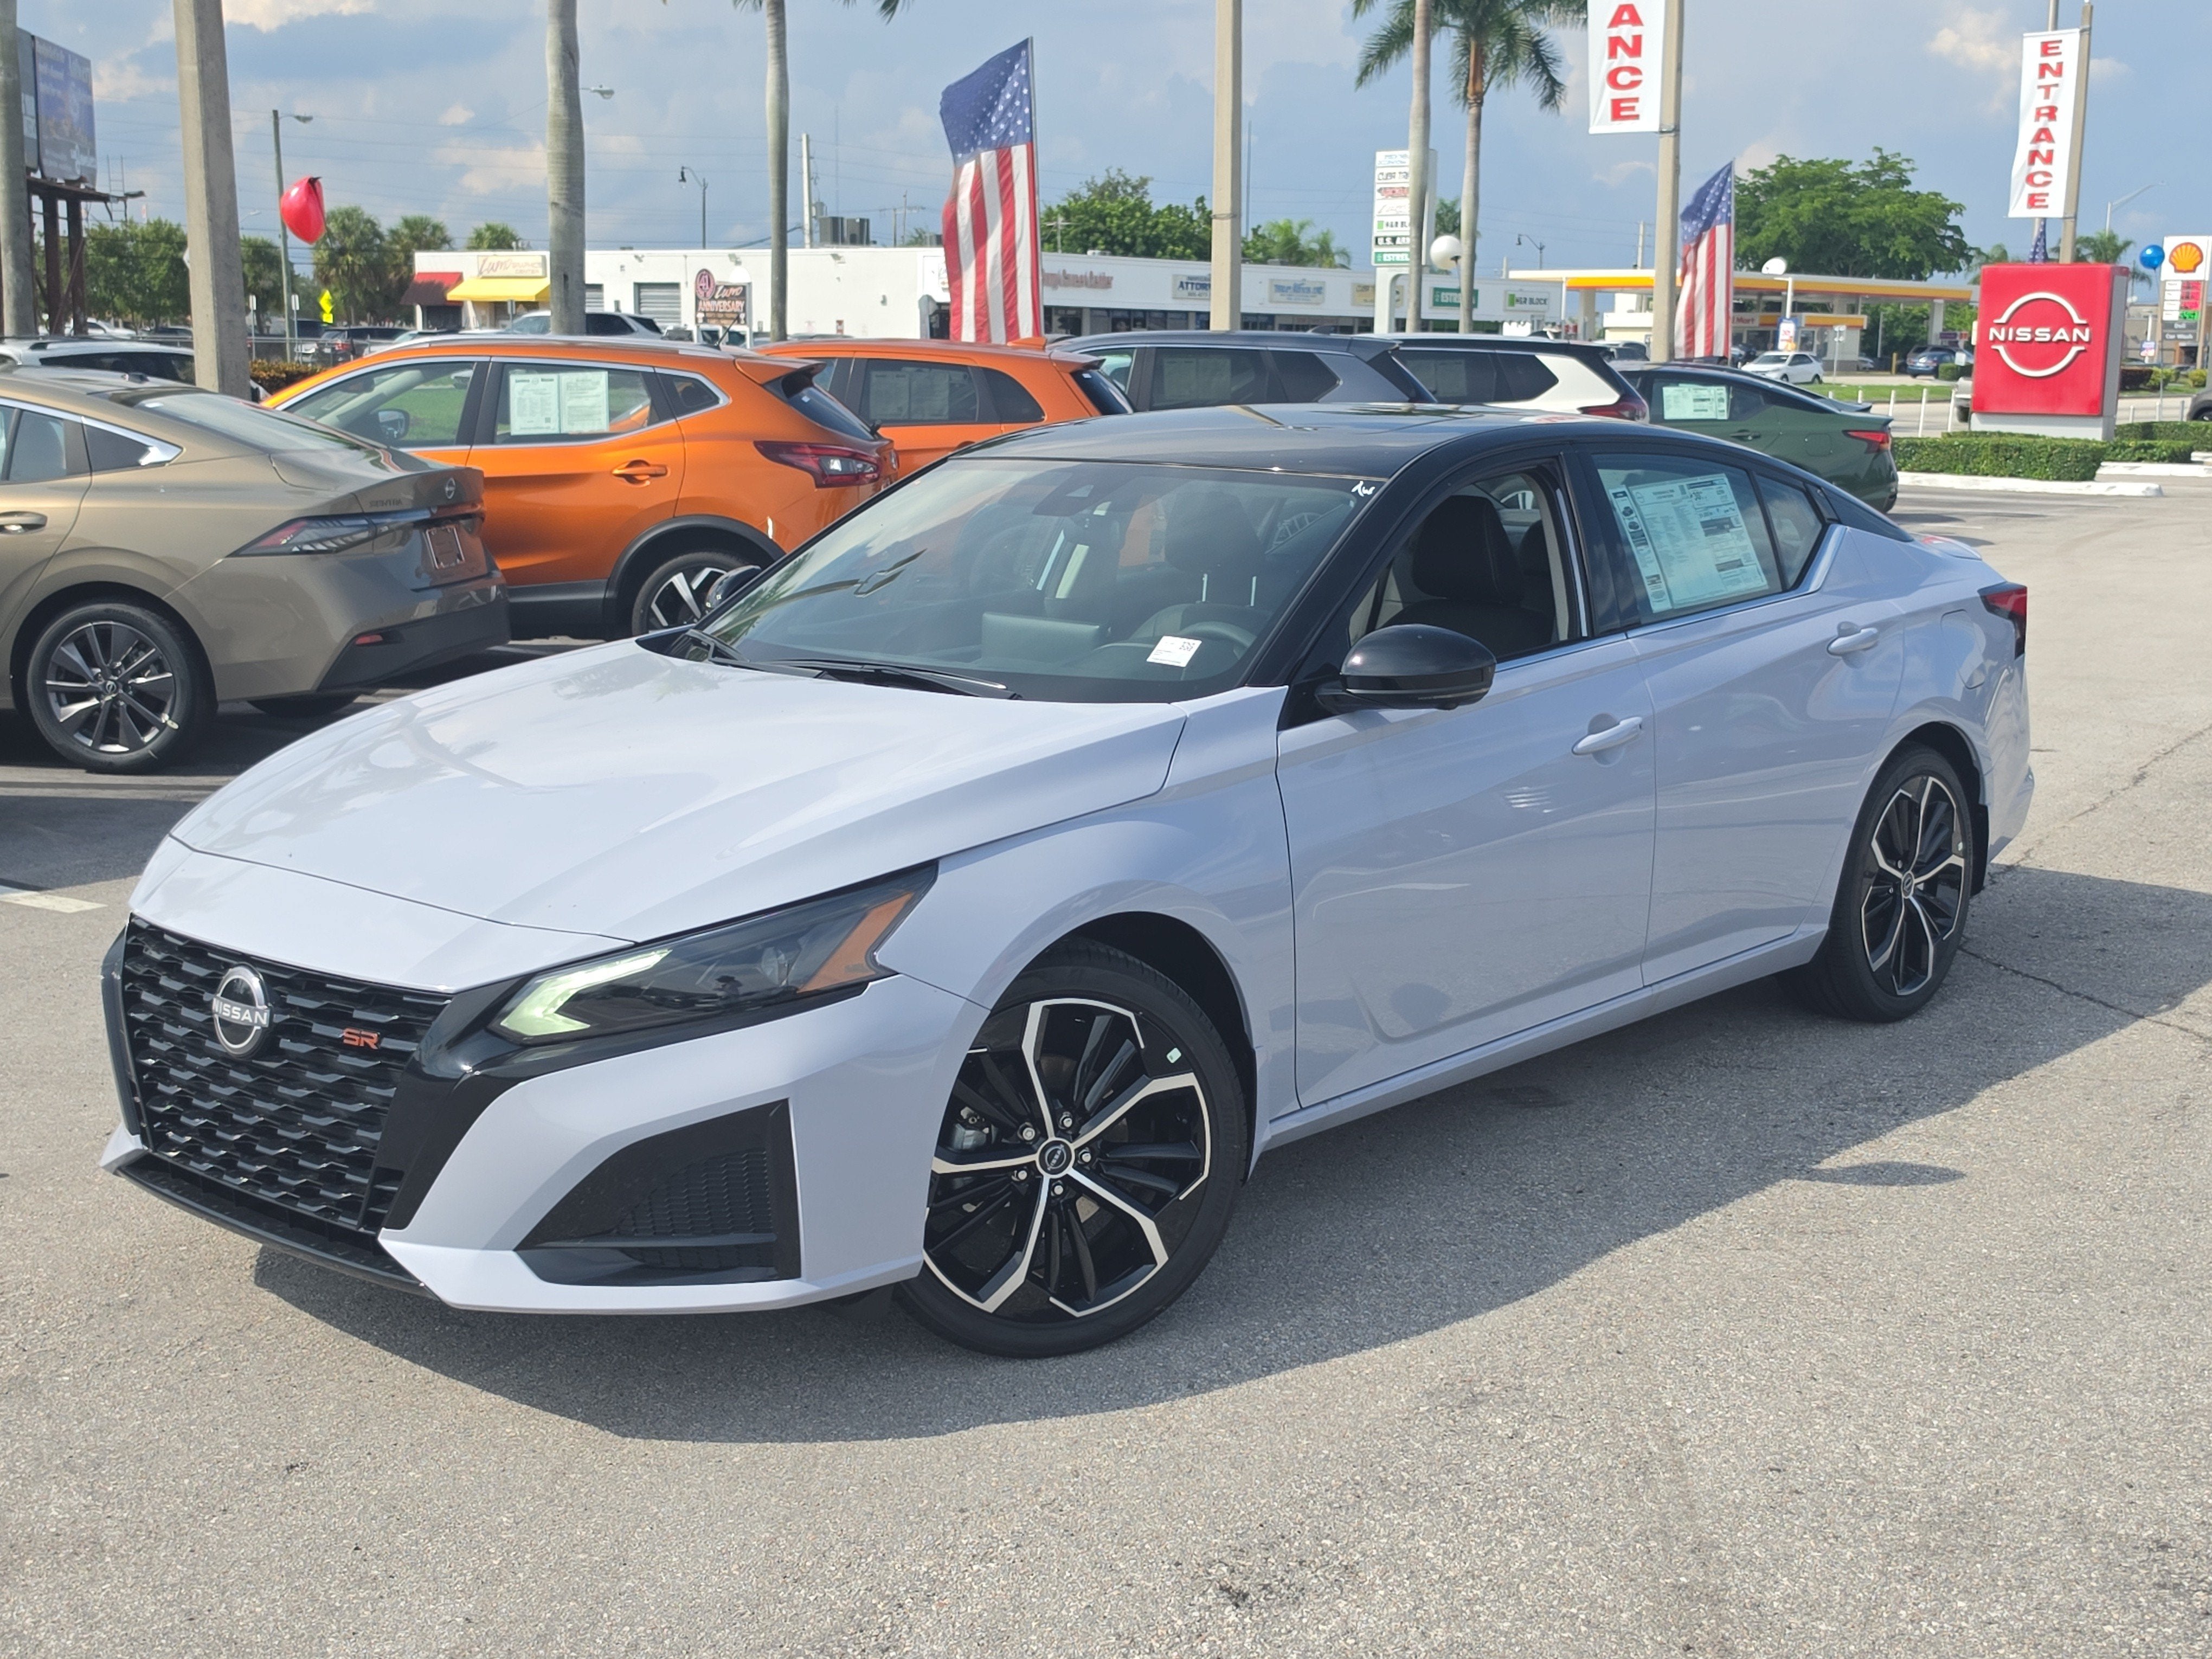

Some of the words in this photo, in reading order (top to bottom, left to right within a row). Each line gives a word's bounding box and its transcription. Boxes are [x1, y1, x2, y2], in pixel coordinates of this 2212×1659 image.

[1606, 3, 1644, 121] ANCE
[2025, 40, 2063, 209] ENTRANCE
[698, 299, 745, 312] ANNIVERSARY
[1529, 297, 1548, 305] BLOCK
[1989, 327, 2089, 342] NISSAN
[370, 498, 402, 507] SENTRA
[213, 997, 267, 1026] NISSAN
[343, 1027, 378, 1050] SR
